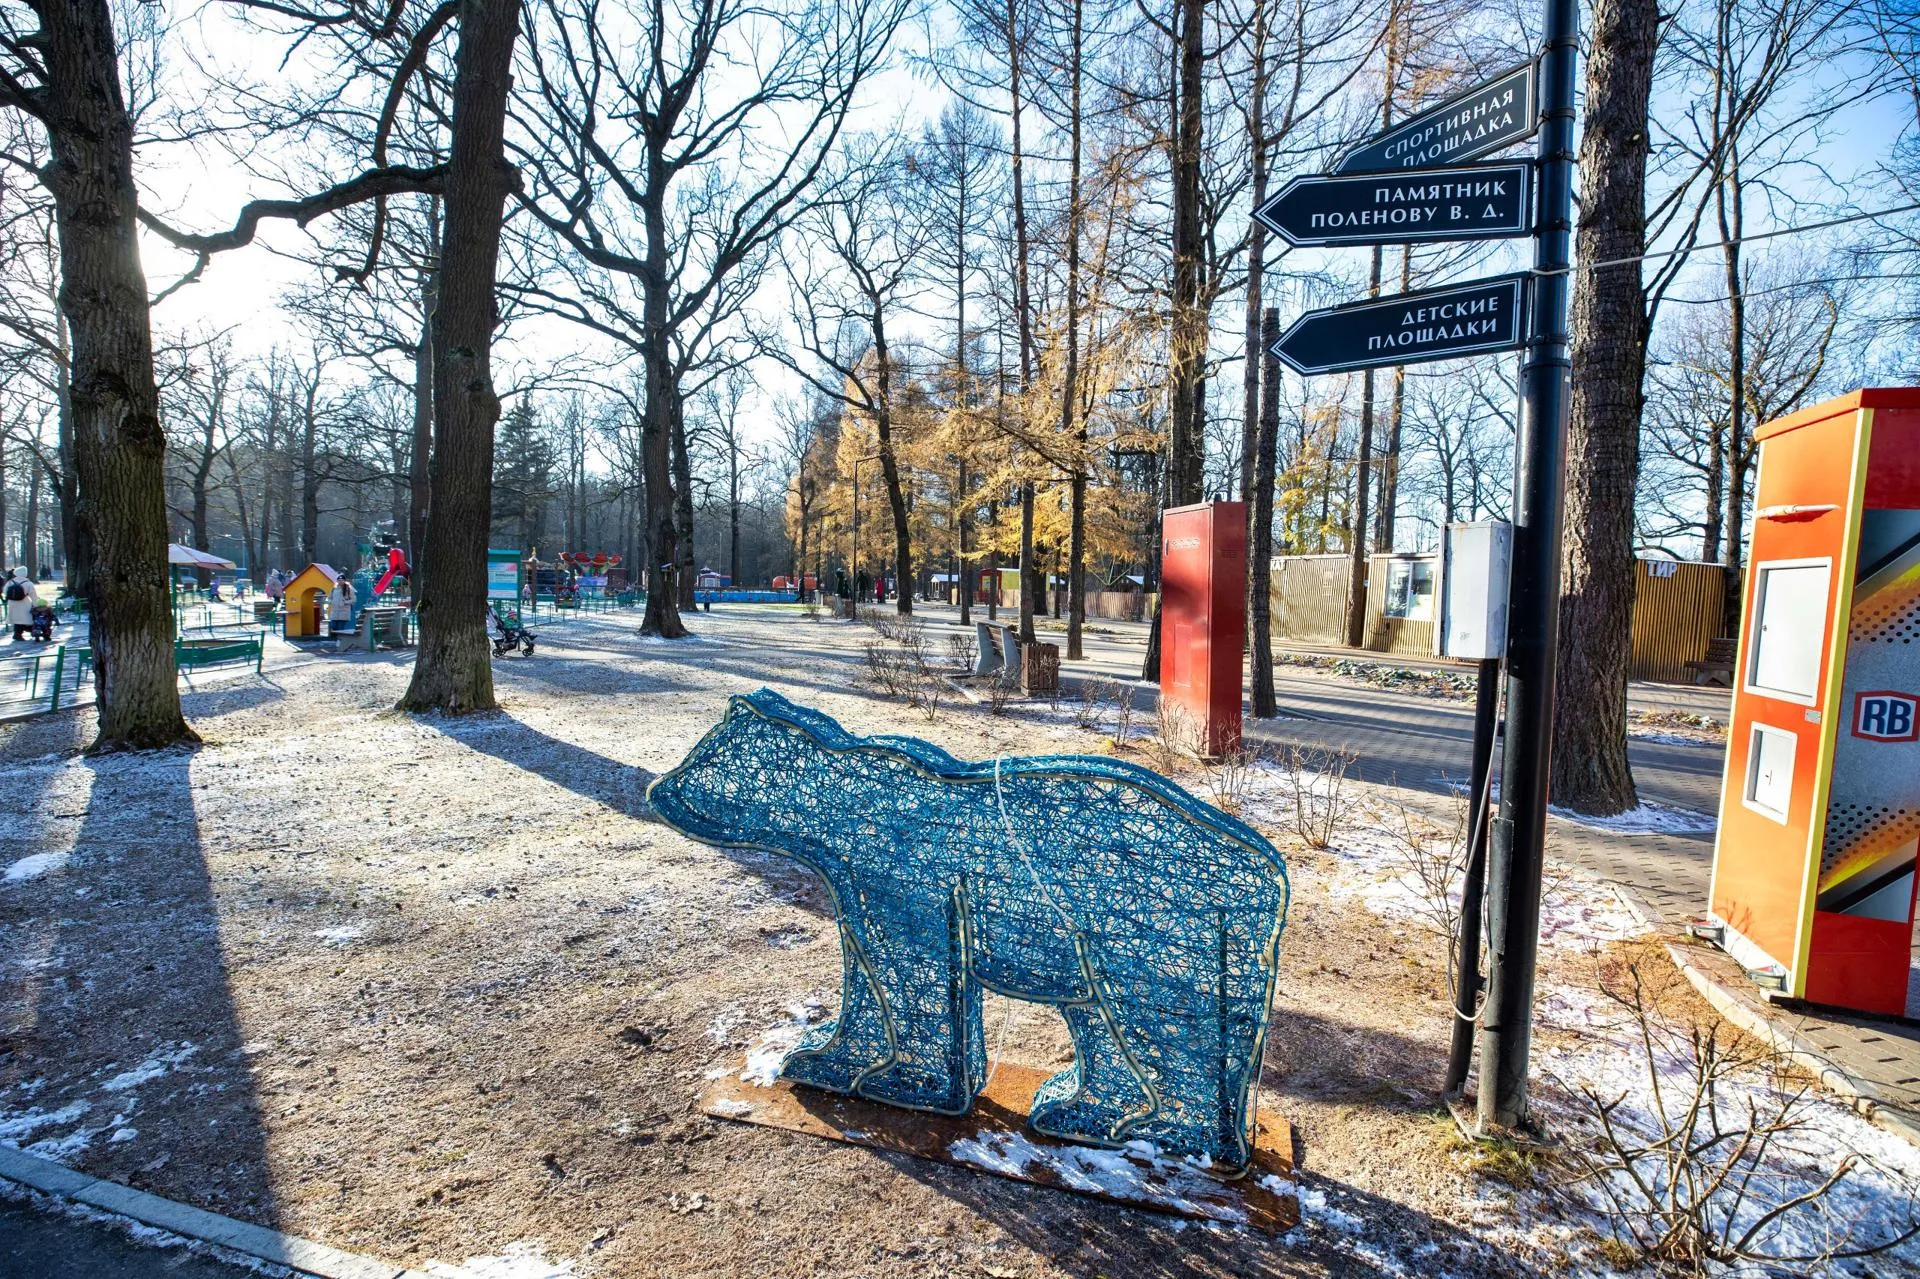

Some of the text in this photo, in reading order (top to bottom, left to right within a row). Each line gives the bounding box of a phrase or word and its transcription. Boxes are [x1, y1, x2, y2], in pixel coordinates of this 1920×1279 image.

[1385, 88, 1513, 160] СПОРТИВНАЯ
[1403, 111, 1513, 167] ПЛОЩАДКА
[1375, 181, 1507, 203] ПАМЯТНИК
[1311, 203, 1505, 229] ПОЛЕНОВУ В. Д.
[1401, 296, 1499, 326] ДЕТСКИЕ
[1368, 318, 1497, 350] ПЛОЩАДКИ
[1647, 560, 1677, 577] ТИР
[1861, 698, 1912, 736] RB
